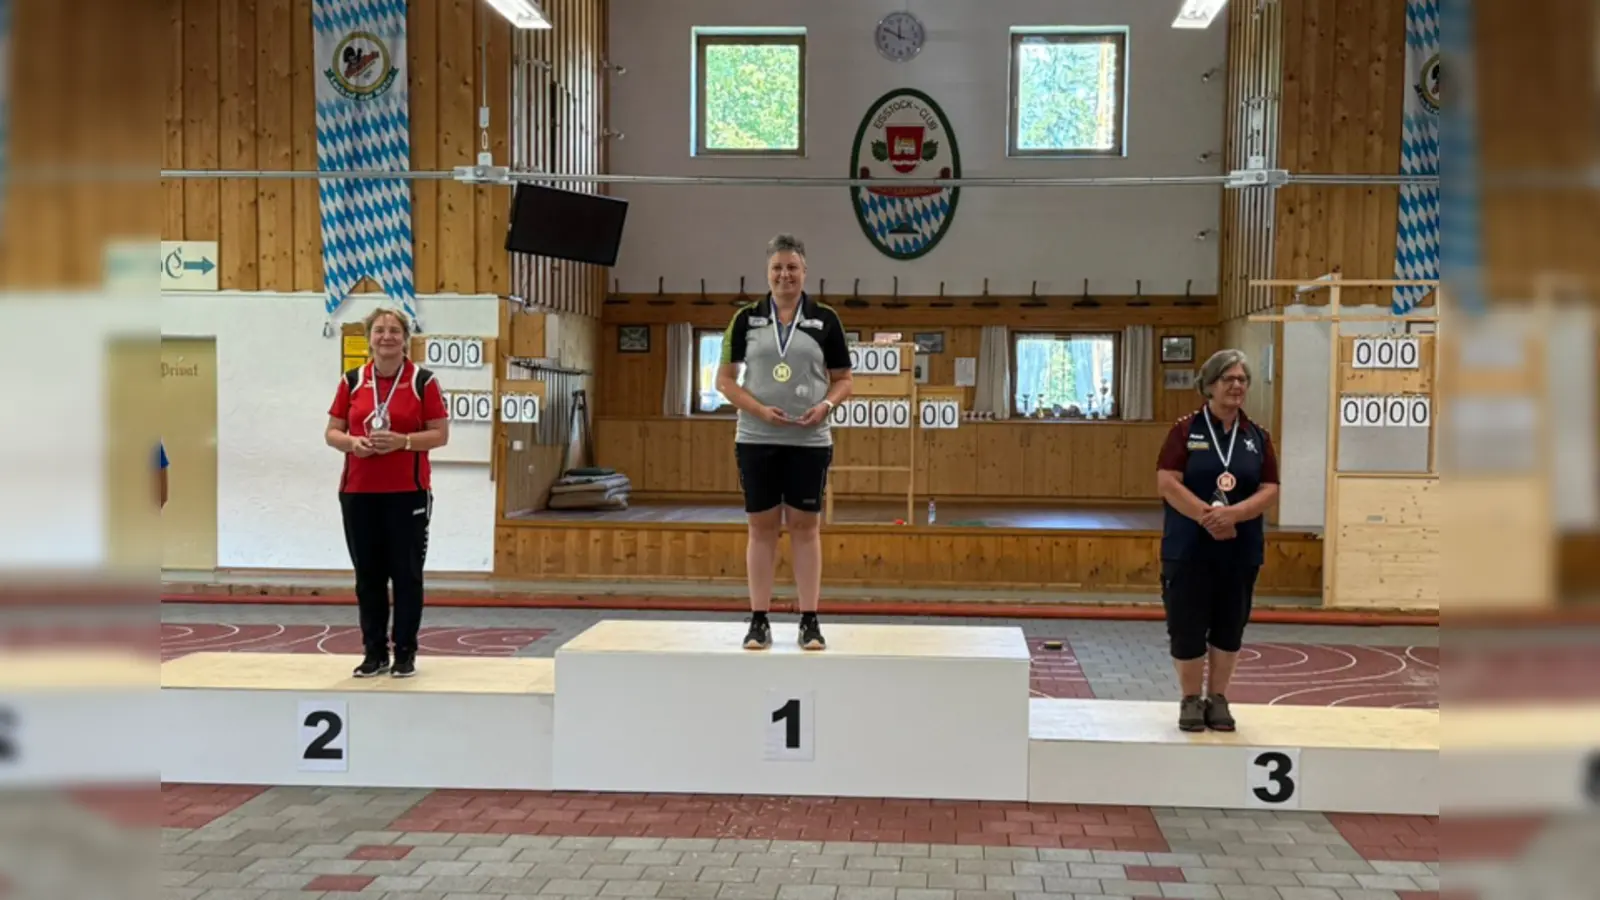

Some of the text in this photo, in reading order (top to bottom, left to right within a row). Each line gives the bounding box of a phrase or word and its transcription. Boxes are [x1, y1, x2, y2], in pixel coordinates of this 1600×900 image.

[303, 709, 344, 760] 2
[771, 699, 801, 749] 1
[1252, 751, 1295, 804] 3
